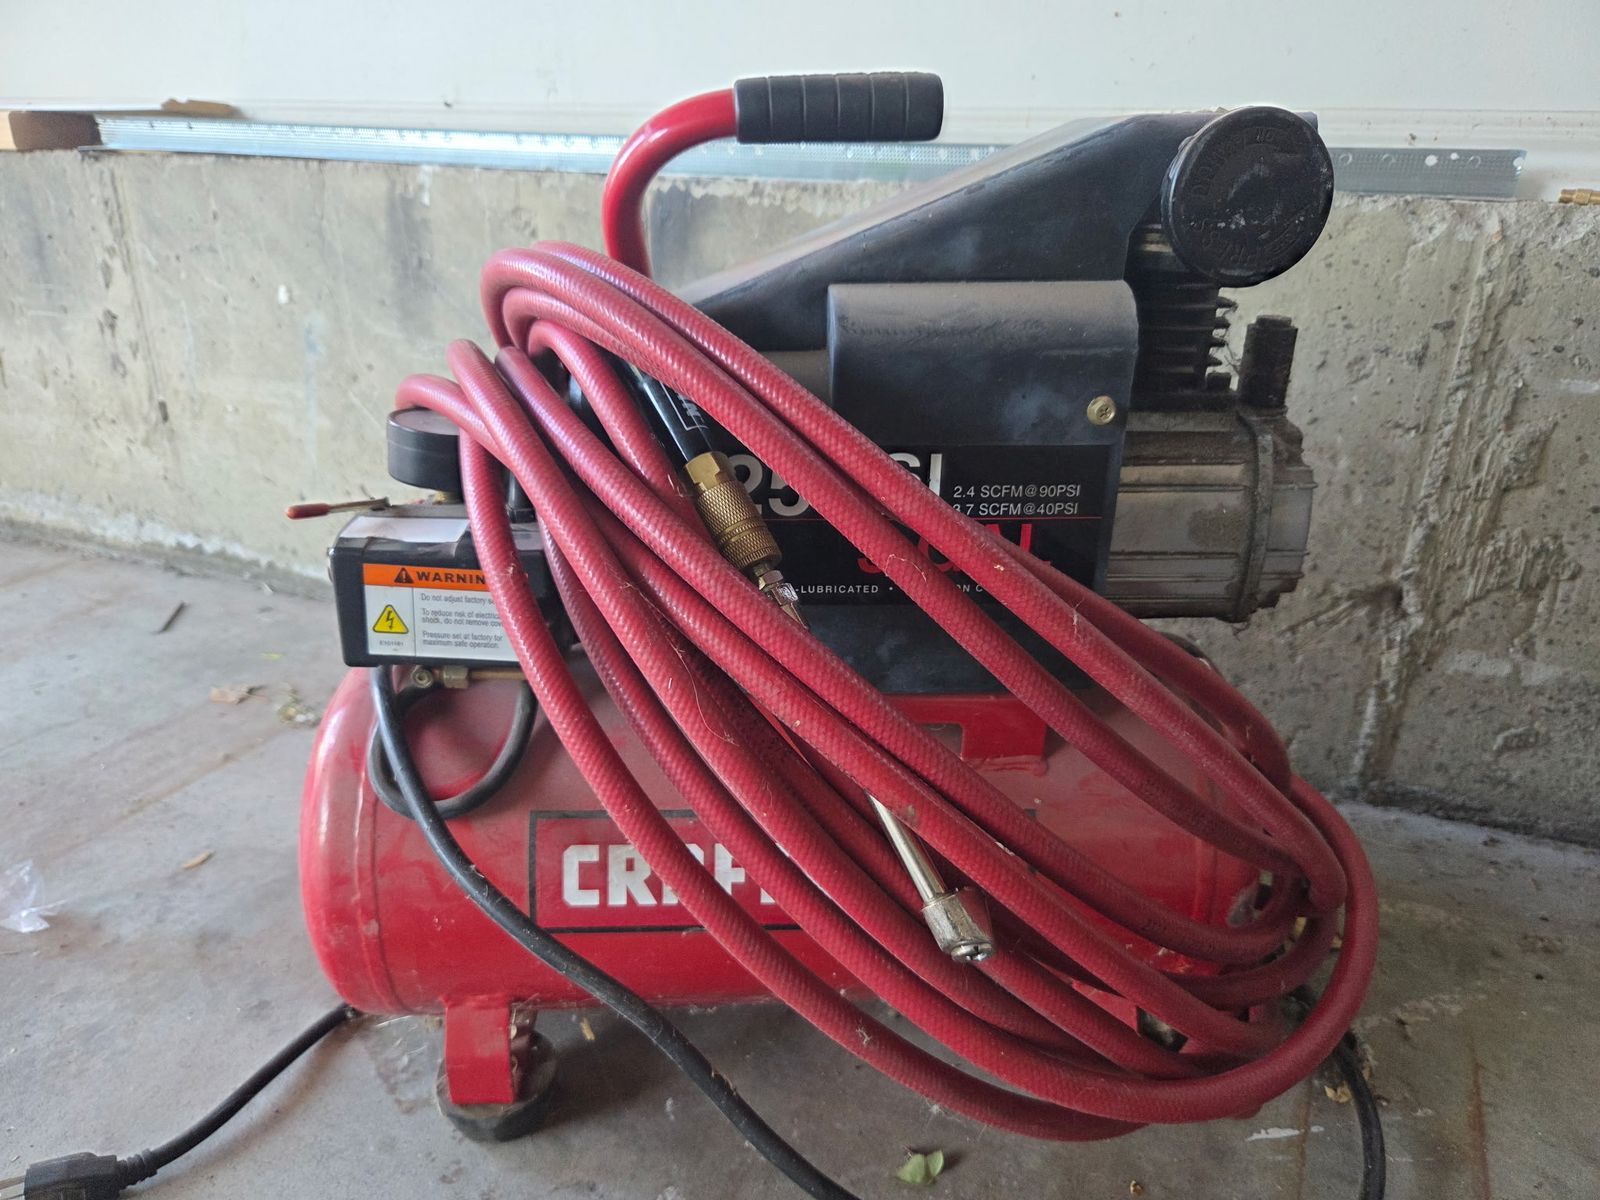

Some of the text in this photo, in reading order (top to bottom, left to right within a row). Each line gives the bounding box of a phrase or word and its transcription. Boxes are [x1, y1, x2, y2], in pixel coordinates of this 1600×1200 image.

[953, 484, 1081, 498] 2.4 SCFM@90PSI
[952, 502, 1079, 516] 37 SCFM@40PSI
[421, 593, 431, 601] Do
[432, 594, 442, 602] not
[444, 595, 463, 604] adjust
[464, 596, 486, 606] factory
[422, 608, 430, 616] To
[431, 608, 452, 617] reduce
[454, 610, 466, 618] risk
[467, 611, 475, 619] of
[444, 617, 453, 625] do
[422, 631, 503, 642] Pressure set at factory for
[422, 639, 452, 647] maximum
[454, 640, 468, 648] safe
